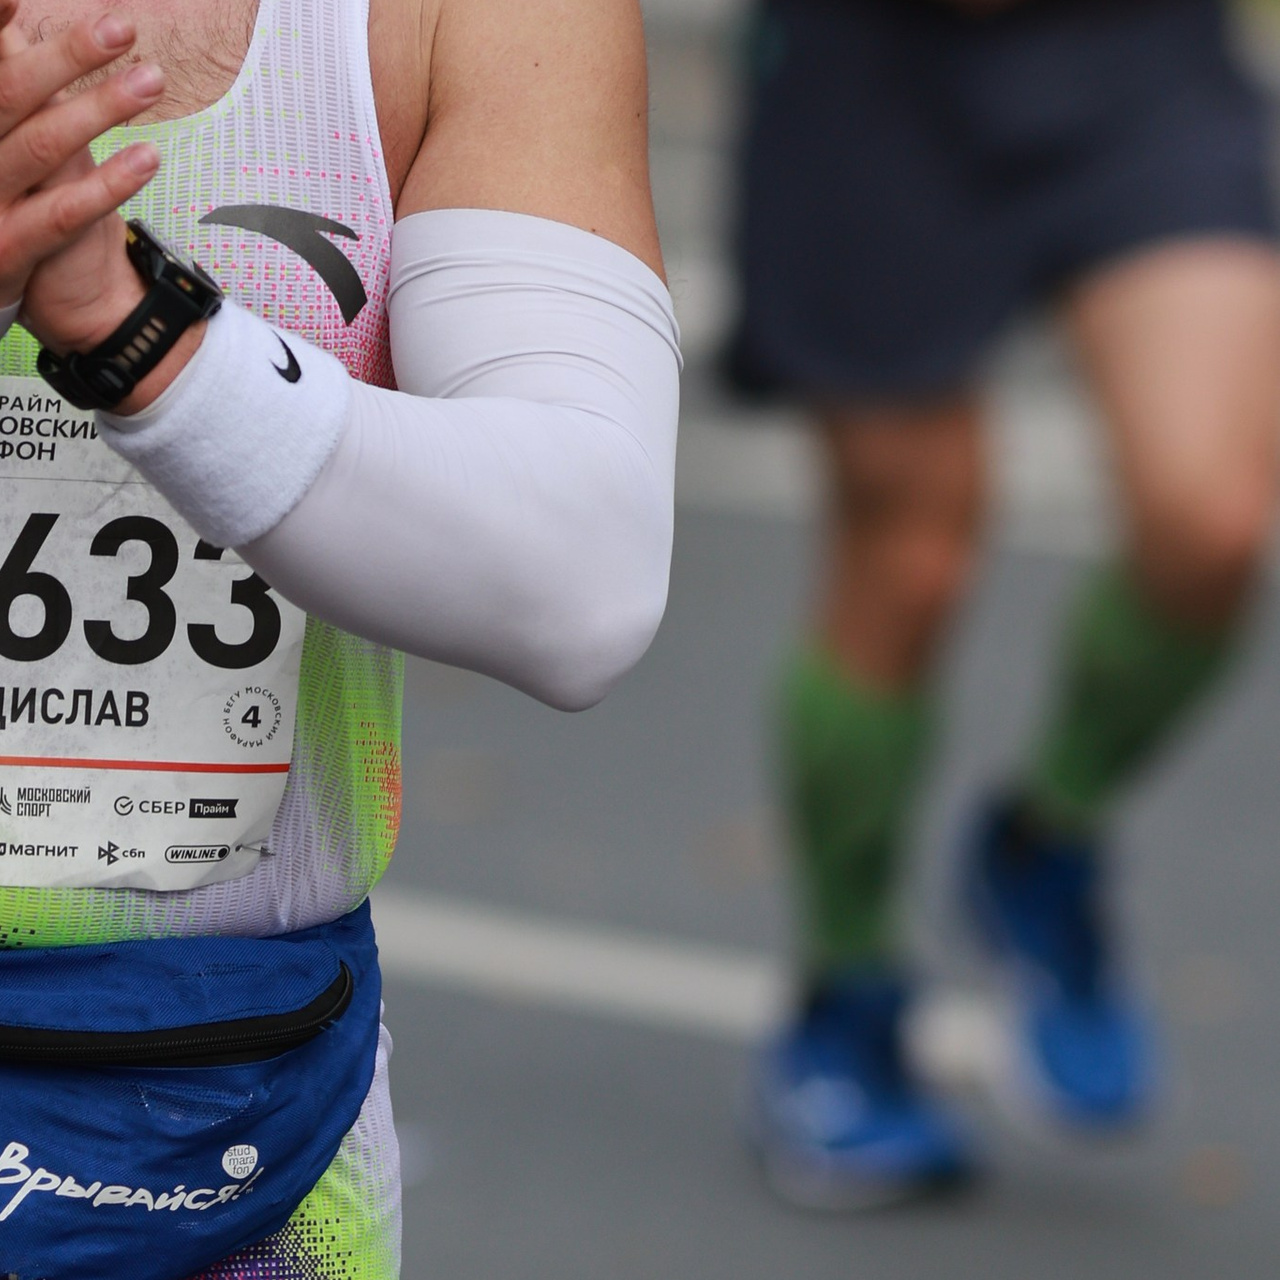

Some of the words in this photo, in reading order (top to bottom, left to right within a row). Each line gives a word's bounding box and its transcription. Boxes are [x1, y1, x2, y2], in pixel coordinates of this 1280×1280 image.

[241, 705, 262, 728] 4
[17, 786, 91, 804] МОСКОВСКИЙ
[16, 802, 51, 817] СПОРТ
[139, 800, 185, 815] СБЕР
[194, 803, 229, 815] Прайм
[9, 843, 79, 858] магнит
[122, 848, 146, 859] сбп
[170, 849, 217, 860] WINLINE
[227, 1145, 251, 1157] stud
[228, 1155, 255, 1166] mara
[232, 1165, 250, 1175] fon
